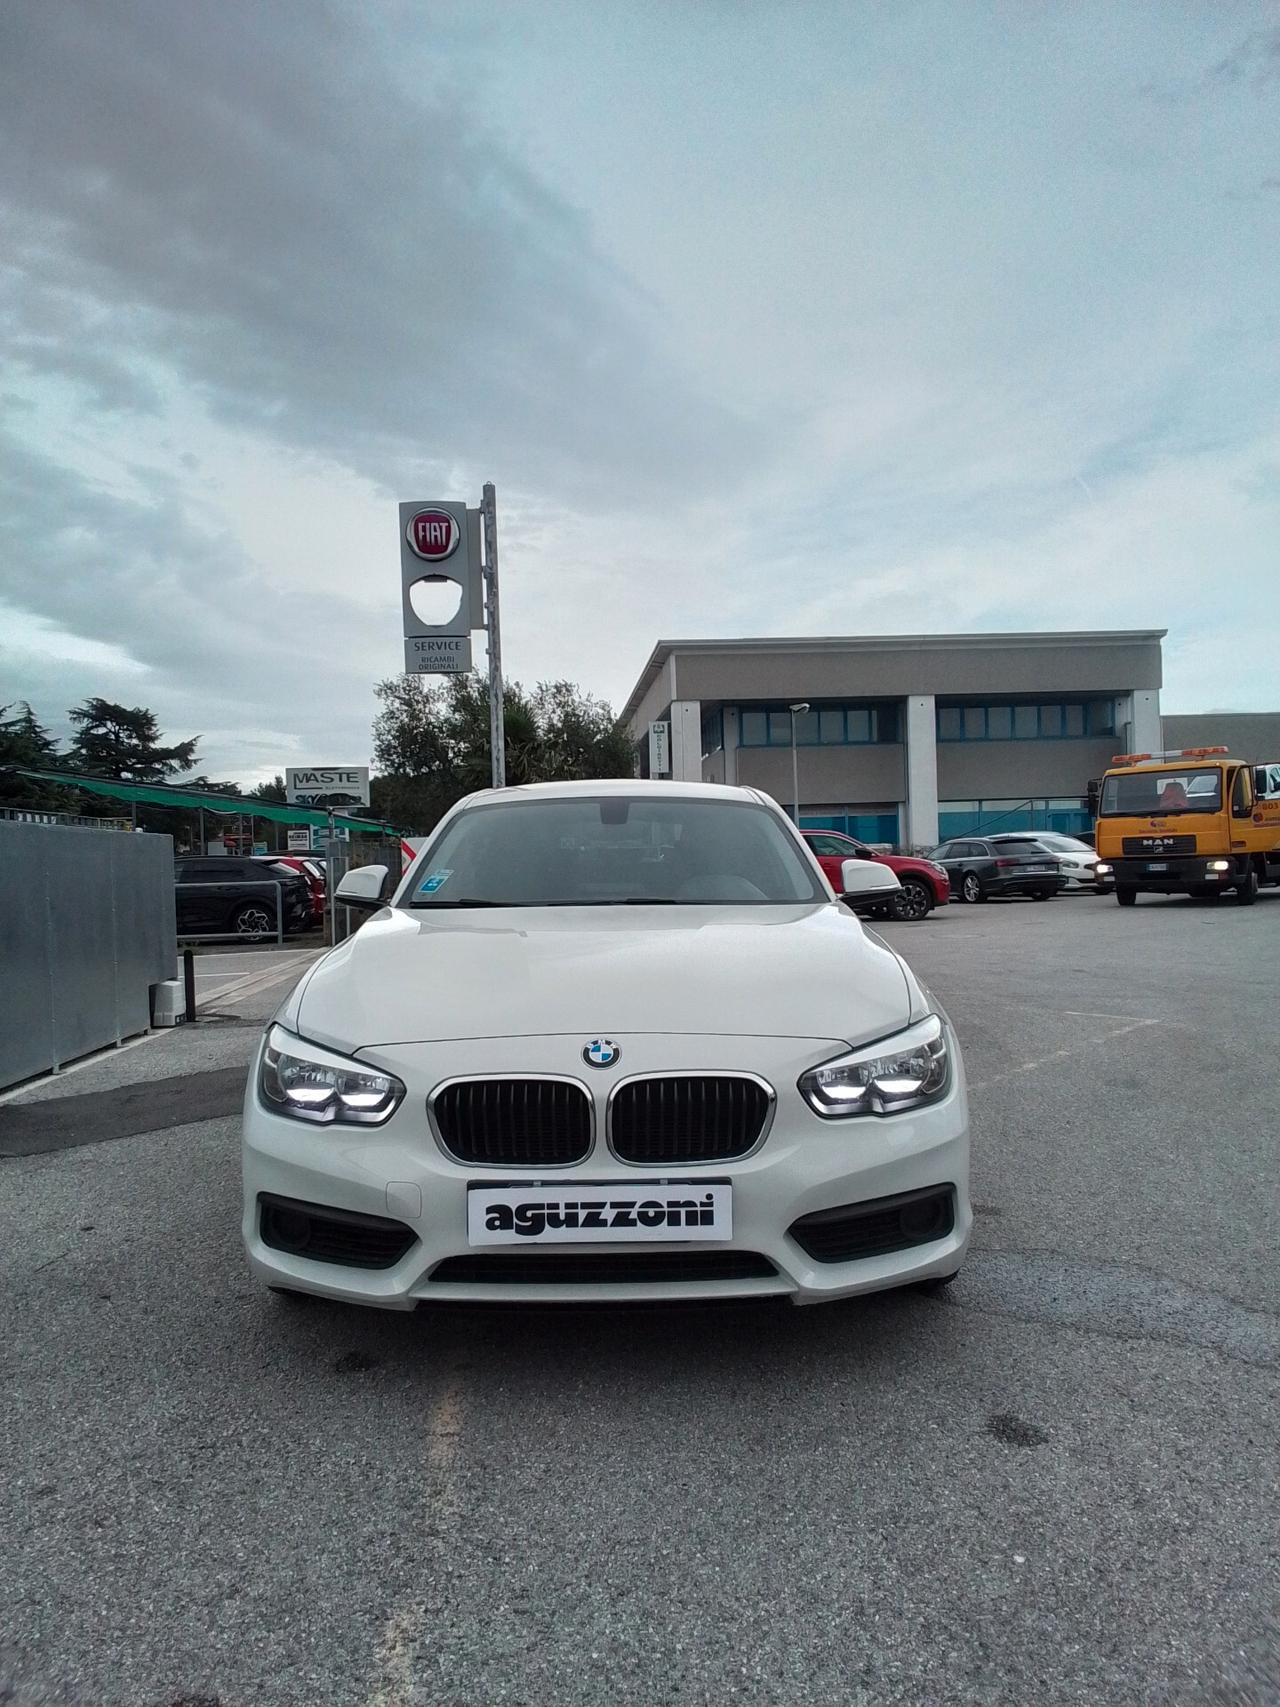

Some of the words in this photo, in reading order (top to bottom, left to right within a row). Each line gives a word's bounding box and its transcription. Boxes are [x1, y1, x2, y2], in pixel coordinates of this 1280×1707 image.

[418, 522, 449, 546] FIAT
[414, 641, 461, 651] SERVICE
[418, 663, 459, 671] ORIGINALI
[1142, 838, 1174, 846] MAN
[485, 1193, 714, 1236] aguzzoni
